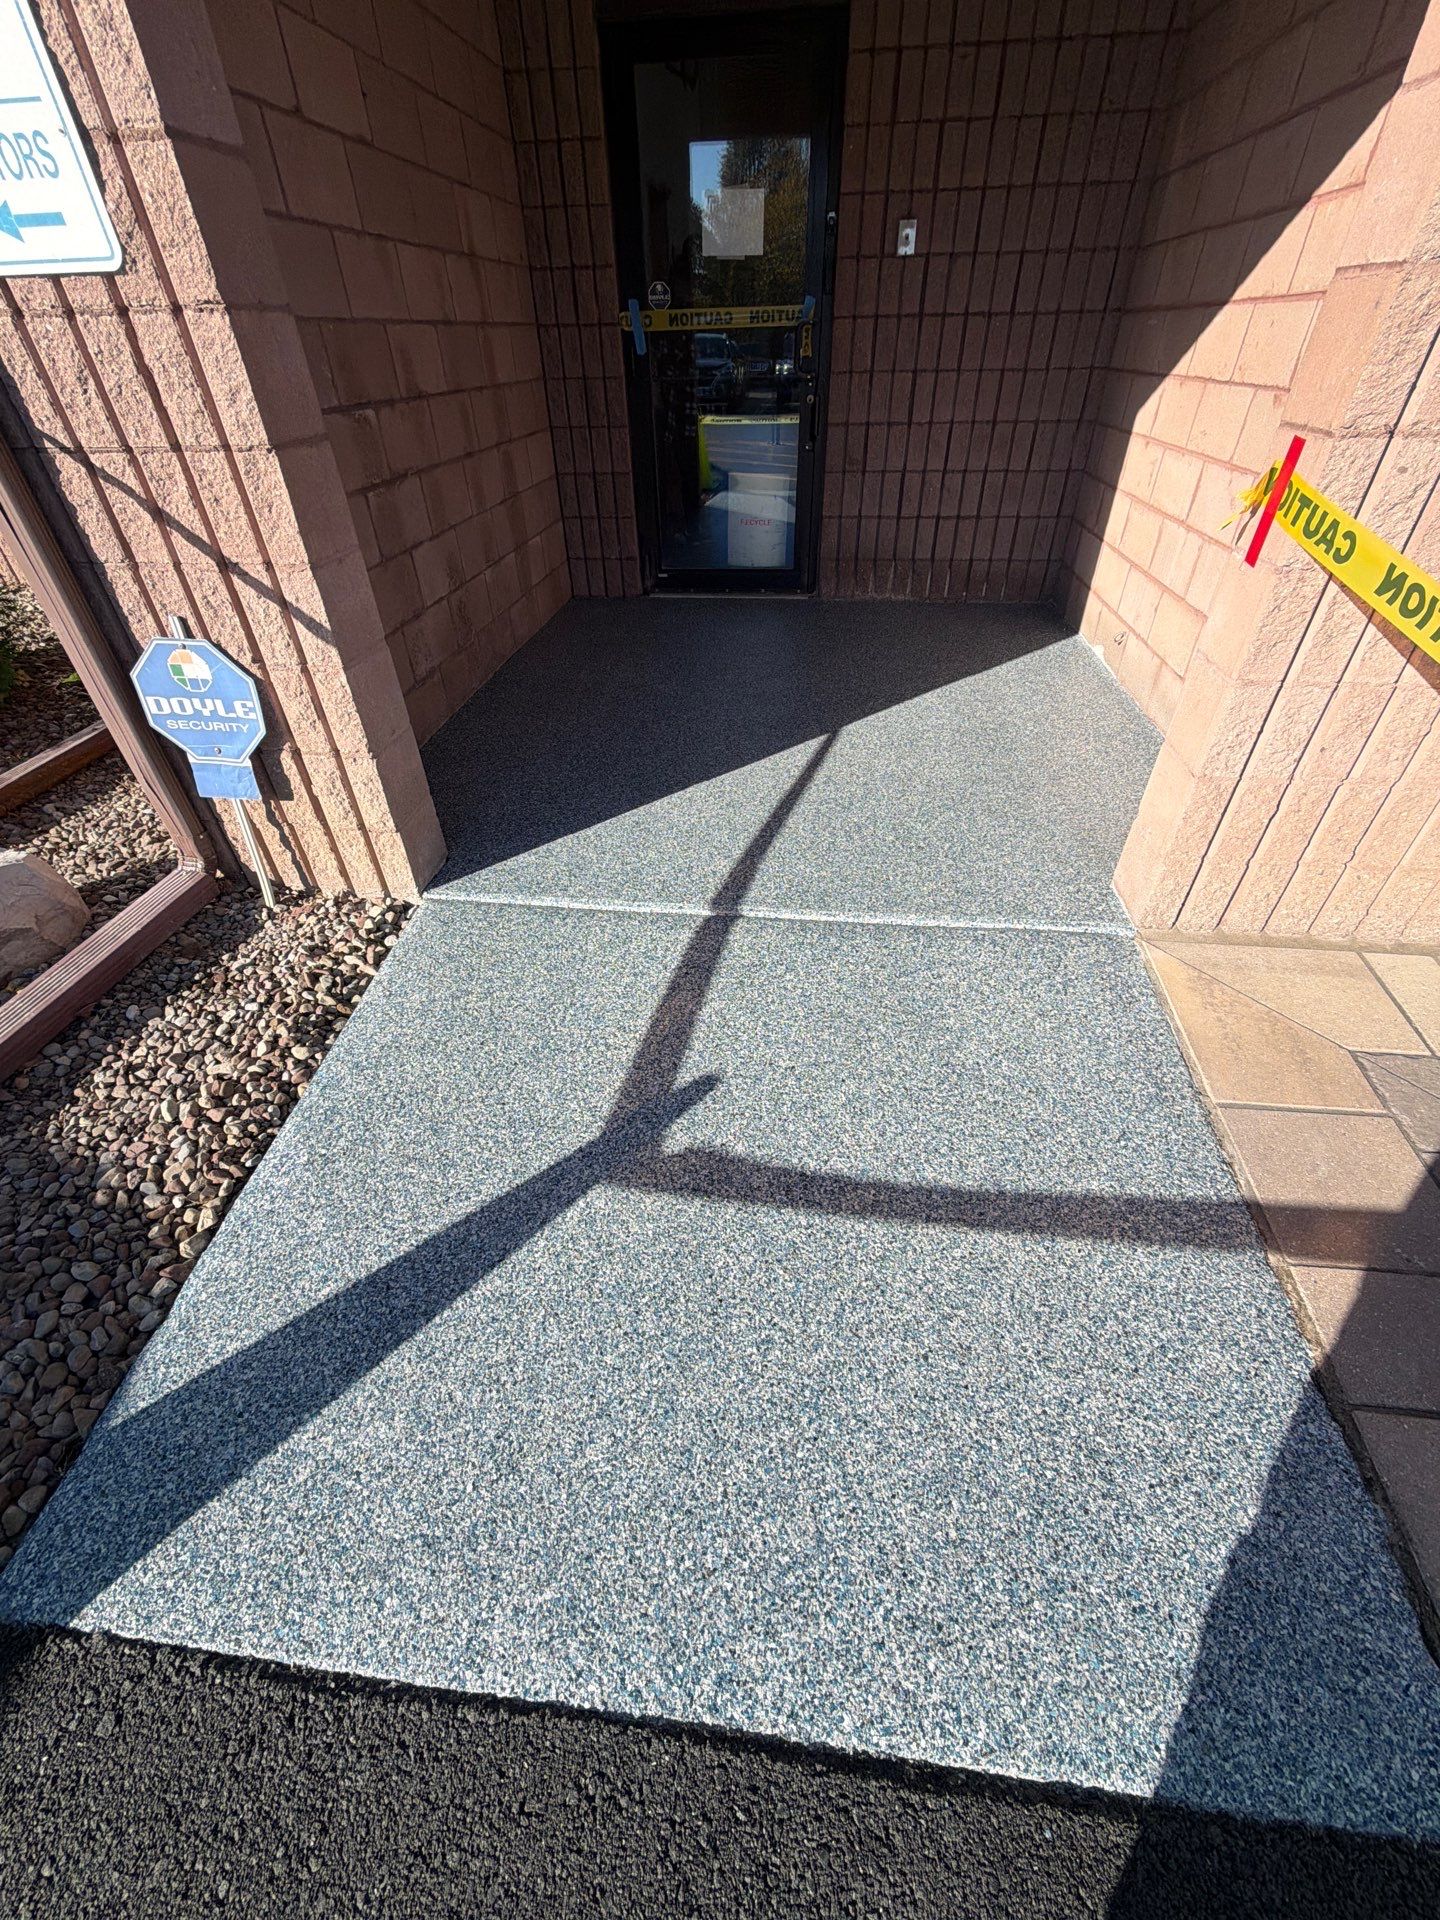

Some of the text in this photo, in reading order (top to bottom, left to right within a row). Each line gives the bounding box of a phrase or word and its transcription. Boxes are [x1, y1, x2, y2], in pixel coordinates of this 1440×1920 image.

[0, 129, 60, 181] ORS
[145, 696, 258, 720] DOYLE
[166, 719, 249, 733] SECURITY
